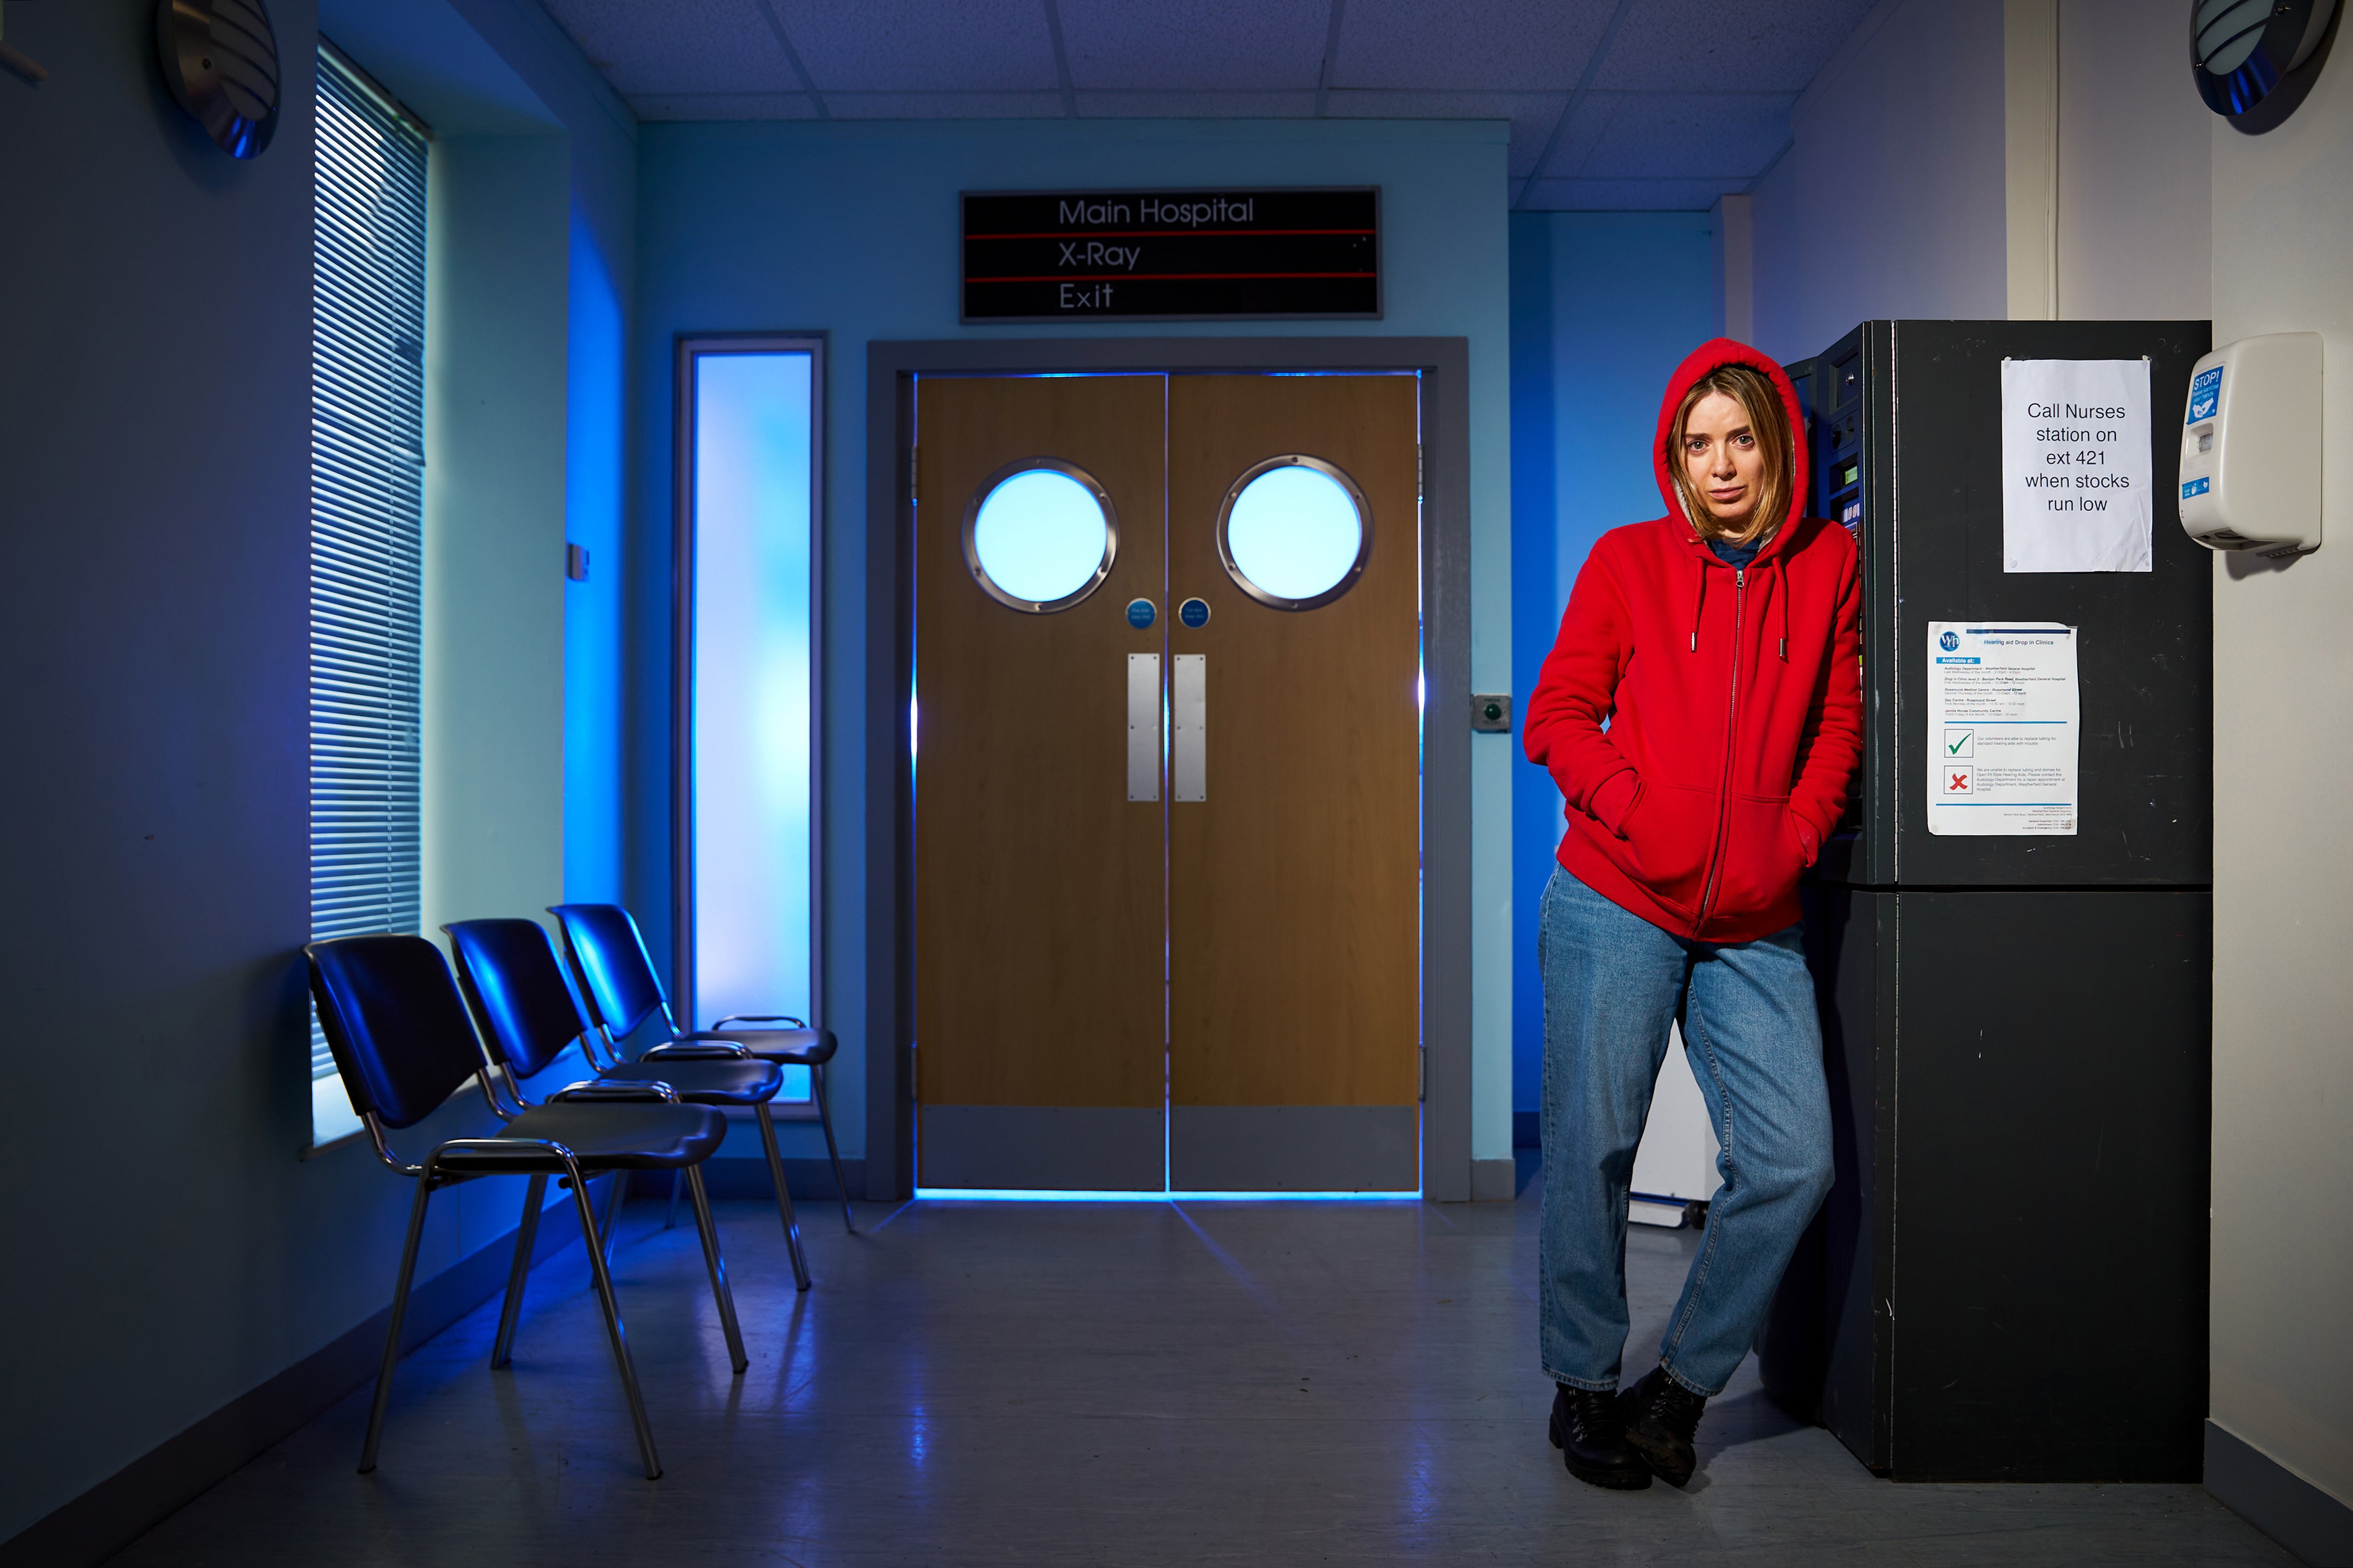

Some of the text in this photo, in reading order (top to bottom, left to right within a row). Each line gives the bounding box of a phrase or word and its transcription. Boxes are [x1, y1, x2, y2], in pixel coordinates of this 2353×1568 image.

[1060, 199, 1254, 228] Main Hospital
[1059, 242, 1140, 270] X-Ray
[1060, 283, 1113, 308] Exit
[2194, 371, 2219, 390] STOP!
[2028, 403, 2125, 418] Call Nurses
[2036, 427, 2117, 442] station on
[2046, 451, 2105, 465] ext 421
[2025, 473, 2129, 488] when stocks
[2048, 497, 2107, 511] run low
